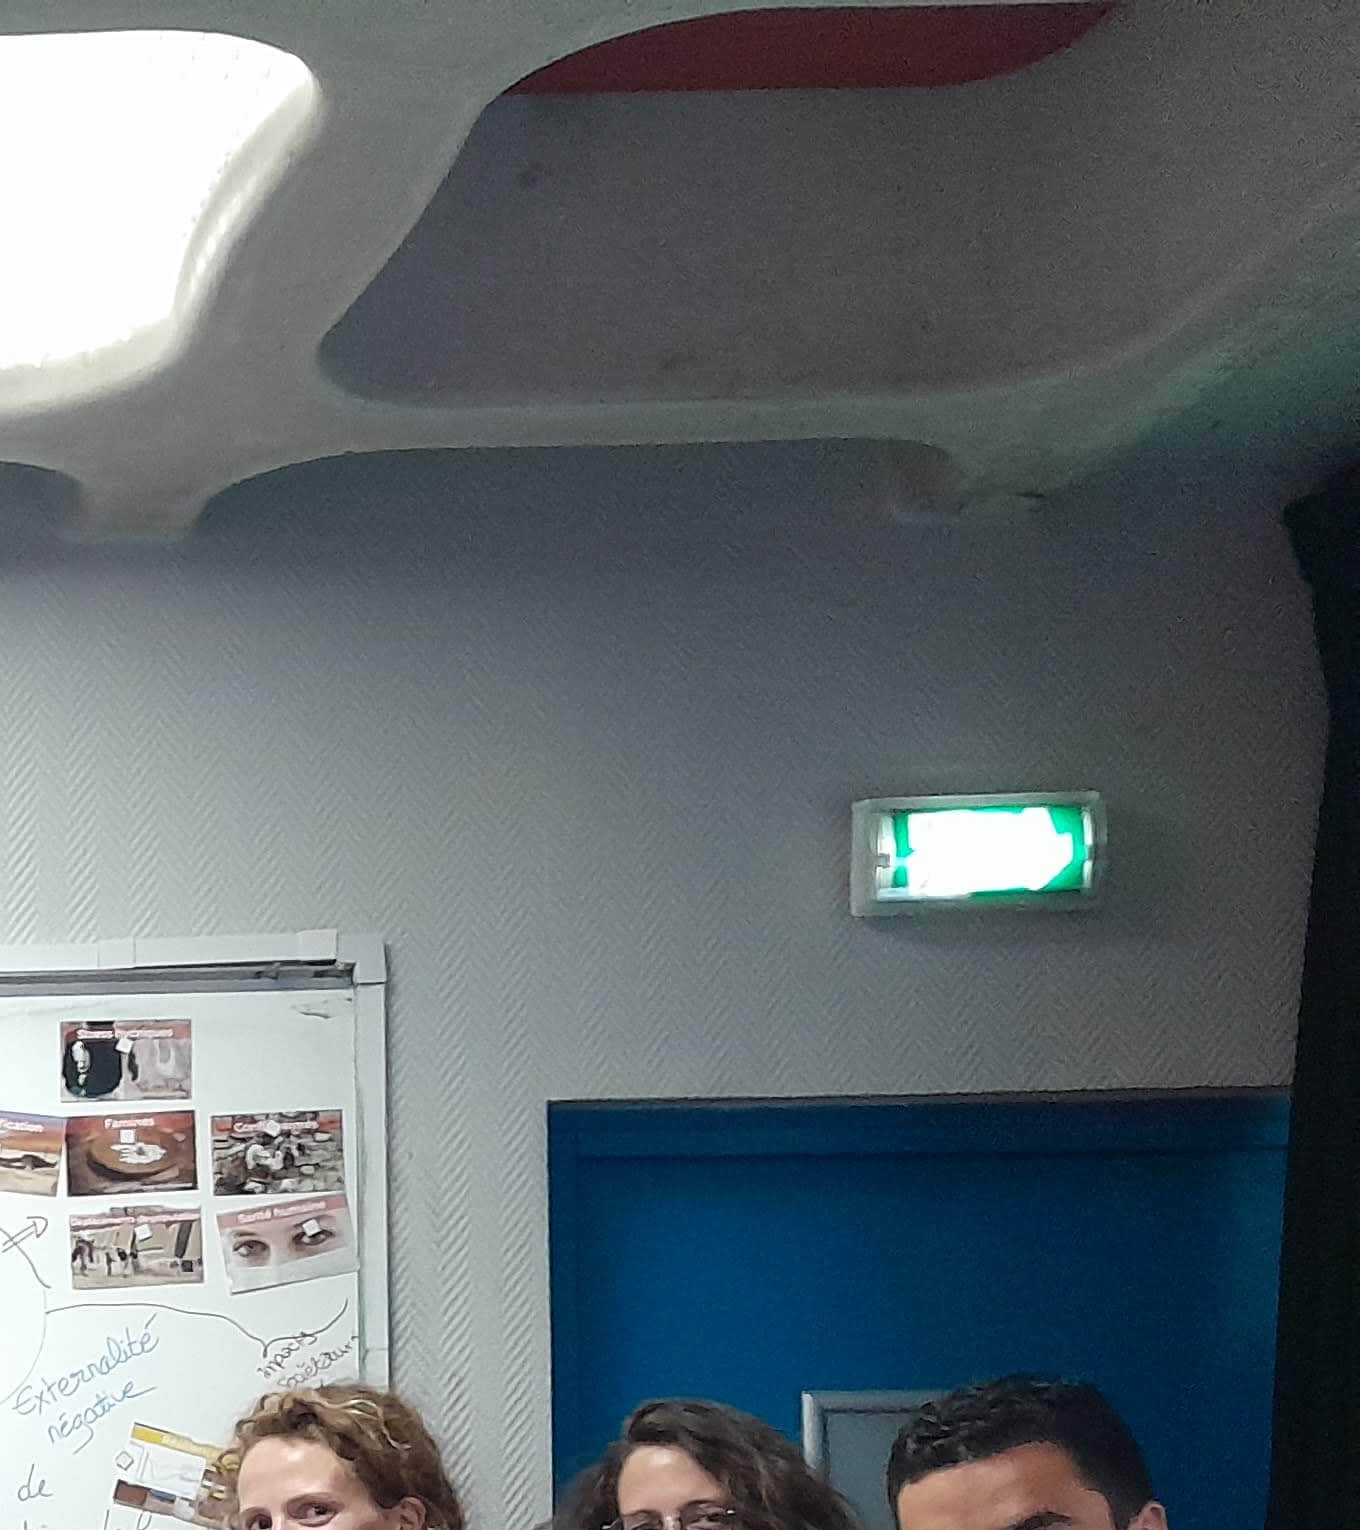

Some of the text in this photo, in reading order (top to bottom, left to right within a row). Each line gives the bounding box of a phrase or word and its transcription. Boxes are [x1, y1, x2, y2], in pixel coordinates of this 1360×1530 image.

[12, 1312, 161, 1418] Externalité
[47, 1380, 158, 1455] négative
[16, 1462, 56, 1503] de
